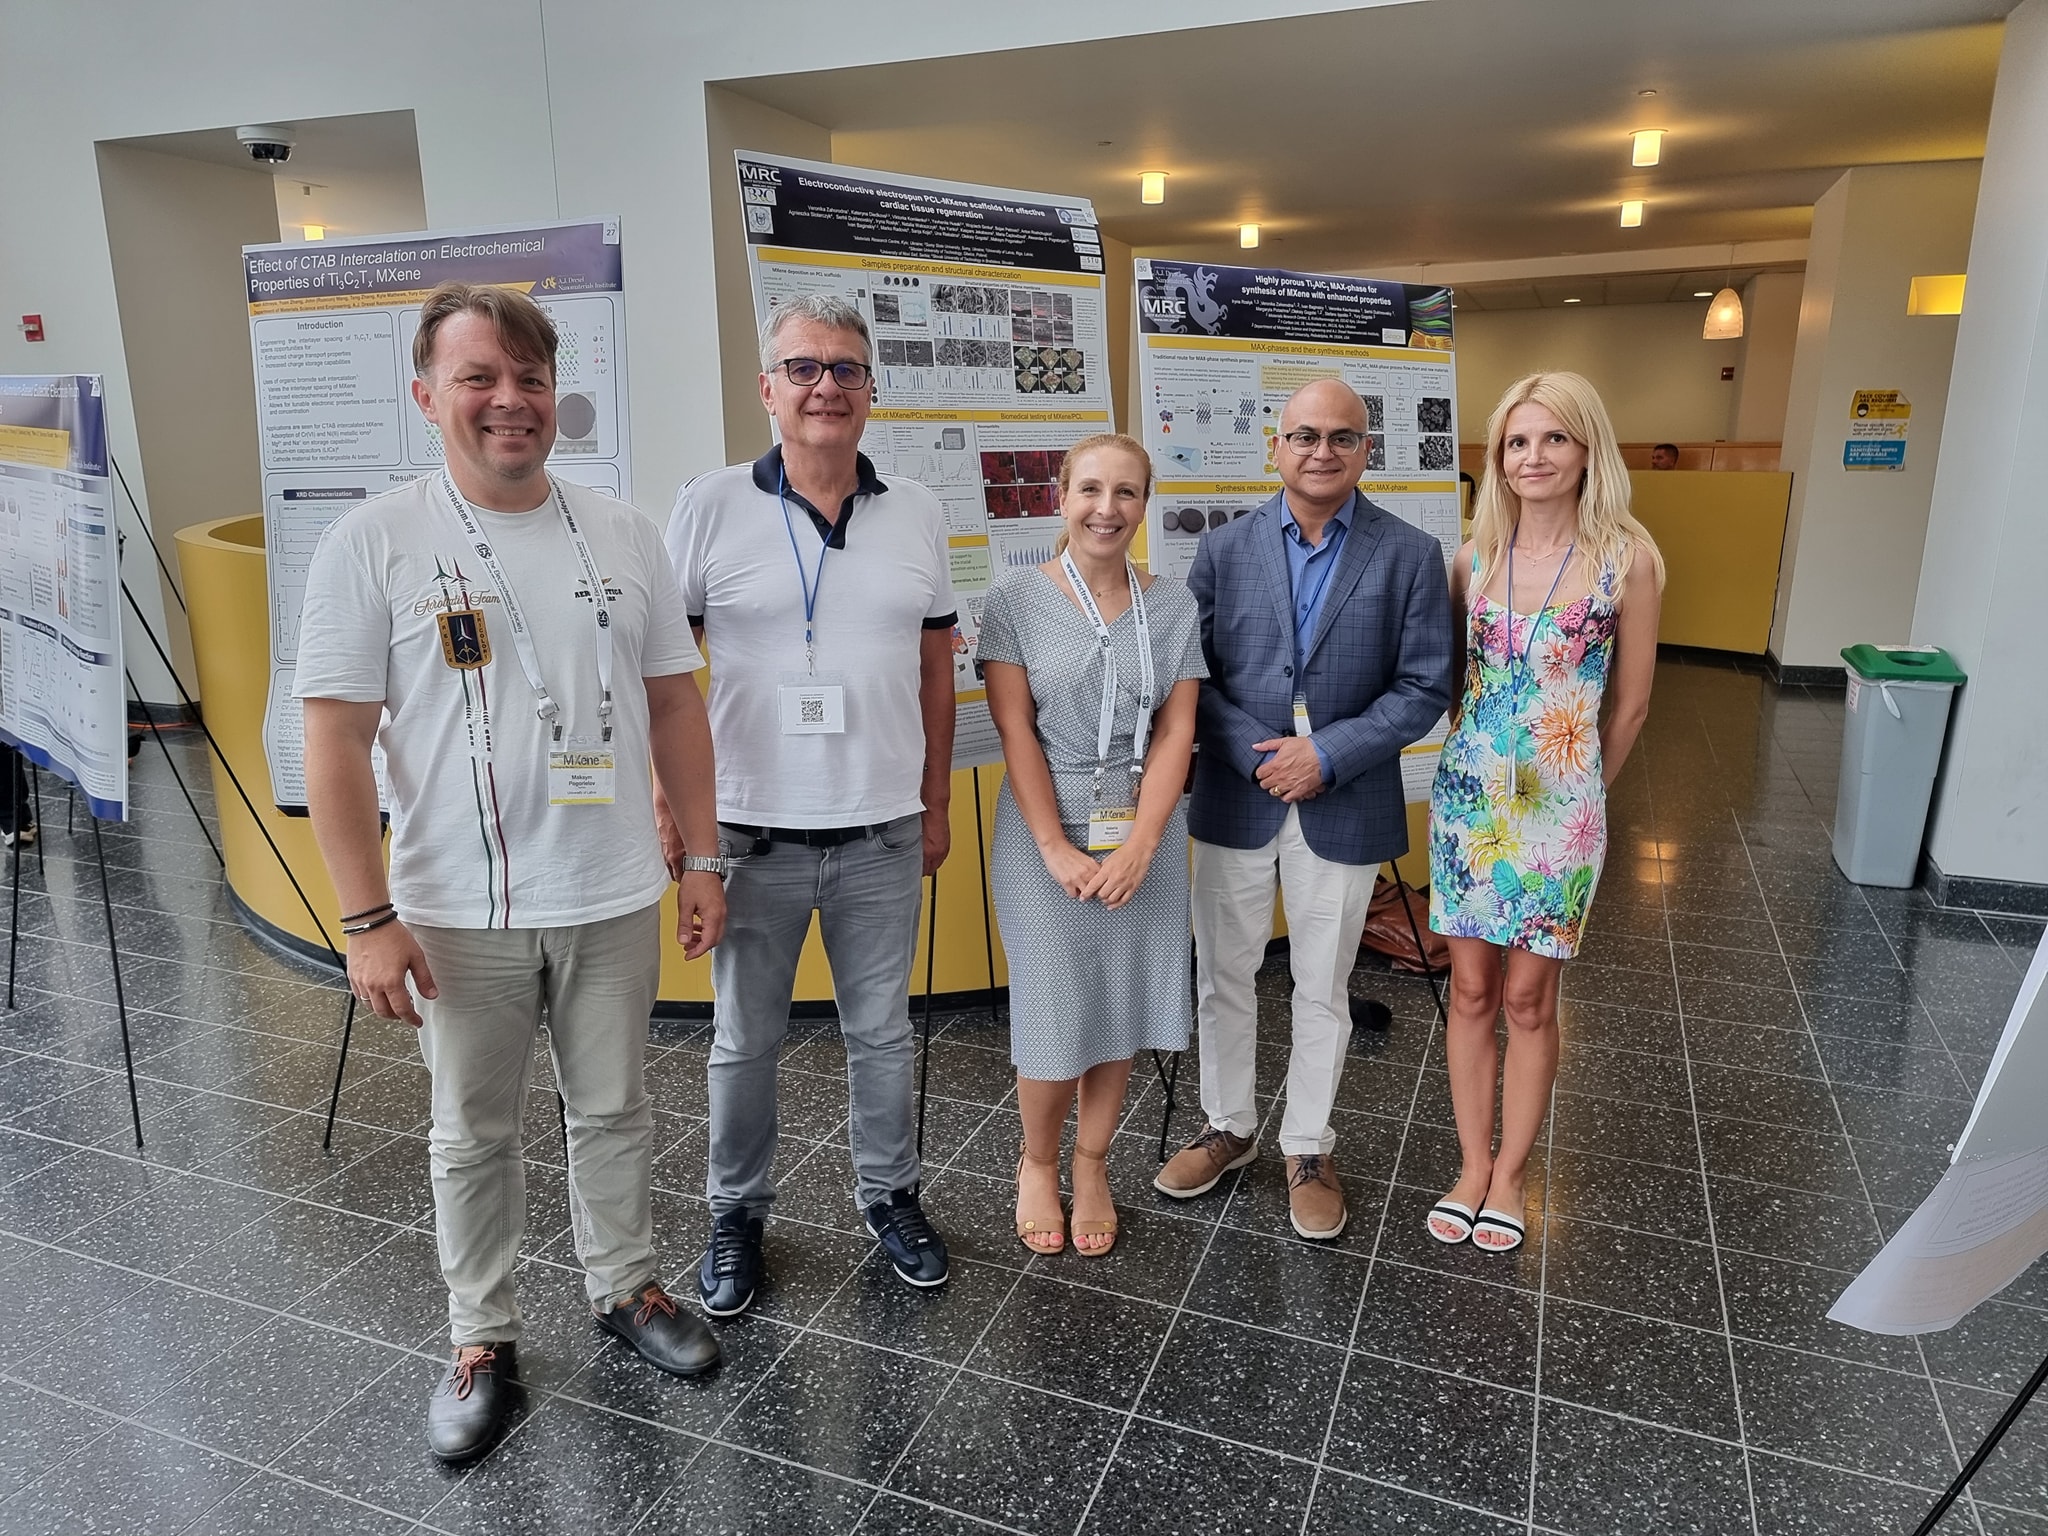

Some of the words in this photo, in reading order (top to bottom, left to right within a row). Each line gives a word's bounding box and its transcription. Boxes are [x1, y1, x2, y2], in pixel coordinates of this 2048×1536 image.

[741, 166, 782, 182] MRC
[798, 177, 874, 196] Electroconductive
[876, 189, 923, 202] electrospun
[923, 195, 968, 207] PCL-MXene
[969, 202, 1003, 212] scaffolds
[1003, 205, 1014, 213] for
[1015, 207, 1046, 217] effective
[880, 200, 910, 211] cardiac
[911, 203, 935, 214] tissue
[936, 207, 984, 220] regeneration
[249, 259, 282, 274] Effect
[285, 256, 298, 271] of
[300, 254, 336, 270] CTAB
[340, 246, 416, 267] Intercalation
[420, 249, 436, 261] on
[440, 237, 545, 259] Electrochemical
[861, 258, 892, 269] Samples
[892, 262, 930, 274] preparation
[931, 264, 944, 273] and
[945, 265, 973, 276] structural
[975, 269, 1022, 280] characterization
[251, 276, 310, 294] Properties
[313, 272, 326, 287] of
[376, 267, 421, 283] MXene
[1255, 275, 1279, 286] Highly
[1330, 282, 1367, 293] MAX-phase
[1368, 285, 1378, 294] for
[1241, 286, 1277, 296] synthesis
[1278, 288, 1286, 296] of
[1286, 288, 1310, 297] MXene
[1327, 292, 1359, 303] enhanced
[1360, 296, 1392, 306] properties
[1143, 299, 1186, 314] MRC
[297, 320, 344, 331] Introduction
[1250, 343, 1290, 353] MAX-phases
[1303, 346, 1316, 354] their
[1317, 347, 1344, 357] synthesis
[1345, 348, 1369, 357] methods
[883, 412, 889, 420] of
[889, 411, 924, 420] MXene/PCL
[924, 412, 958, 421] membranes
[1000, 412, 1028, 421] Biomedical
[1028, 412, 1045, 422] testing
[1045, 412, 1053, 420] of
[1053, 412, 1084, 421] MXene/PCL
[389, 474, 418, 483] Results
[308, 490, 353, 498] Characterization
[1215, 484, 1246, 493] Synthesis
[1247, 484, 1268, 492] results
[475, 542, 492, 560] ECS
[469, 589, 501, 606] Team
[488, 560, 496, 570] The
[493, 569, 516, 614] Electrochemical
[513, 612, 523, 633] Society
[1066, 562, 1102, 628] www.electrochem.org
[597, 609, 610, 629] ECS
[440, 616, 453, 662] FRECCE
[476, 612, 488, 659] TRICOLORI
